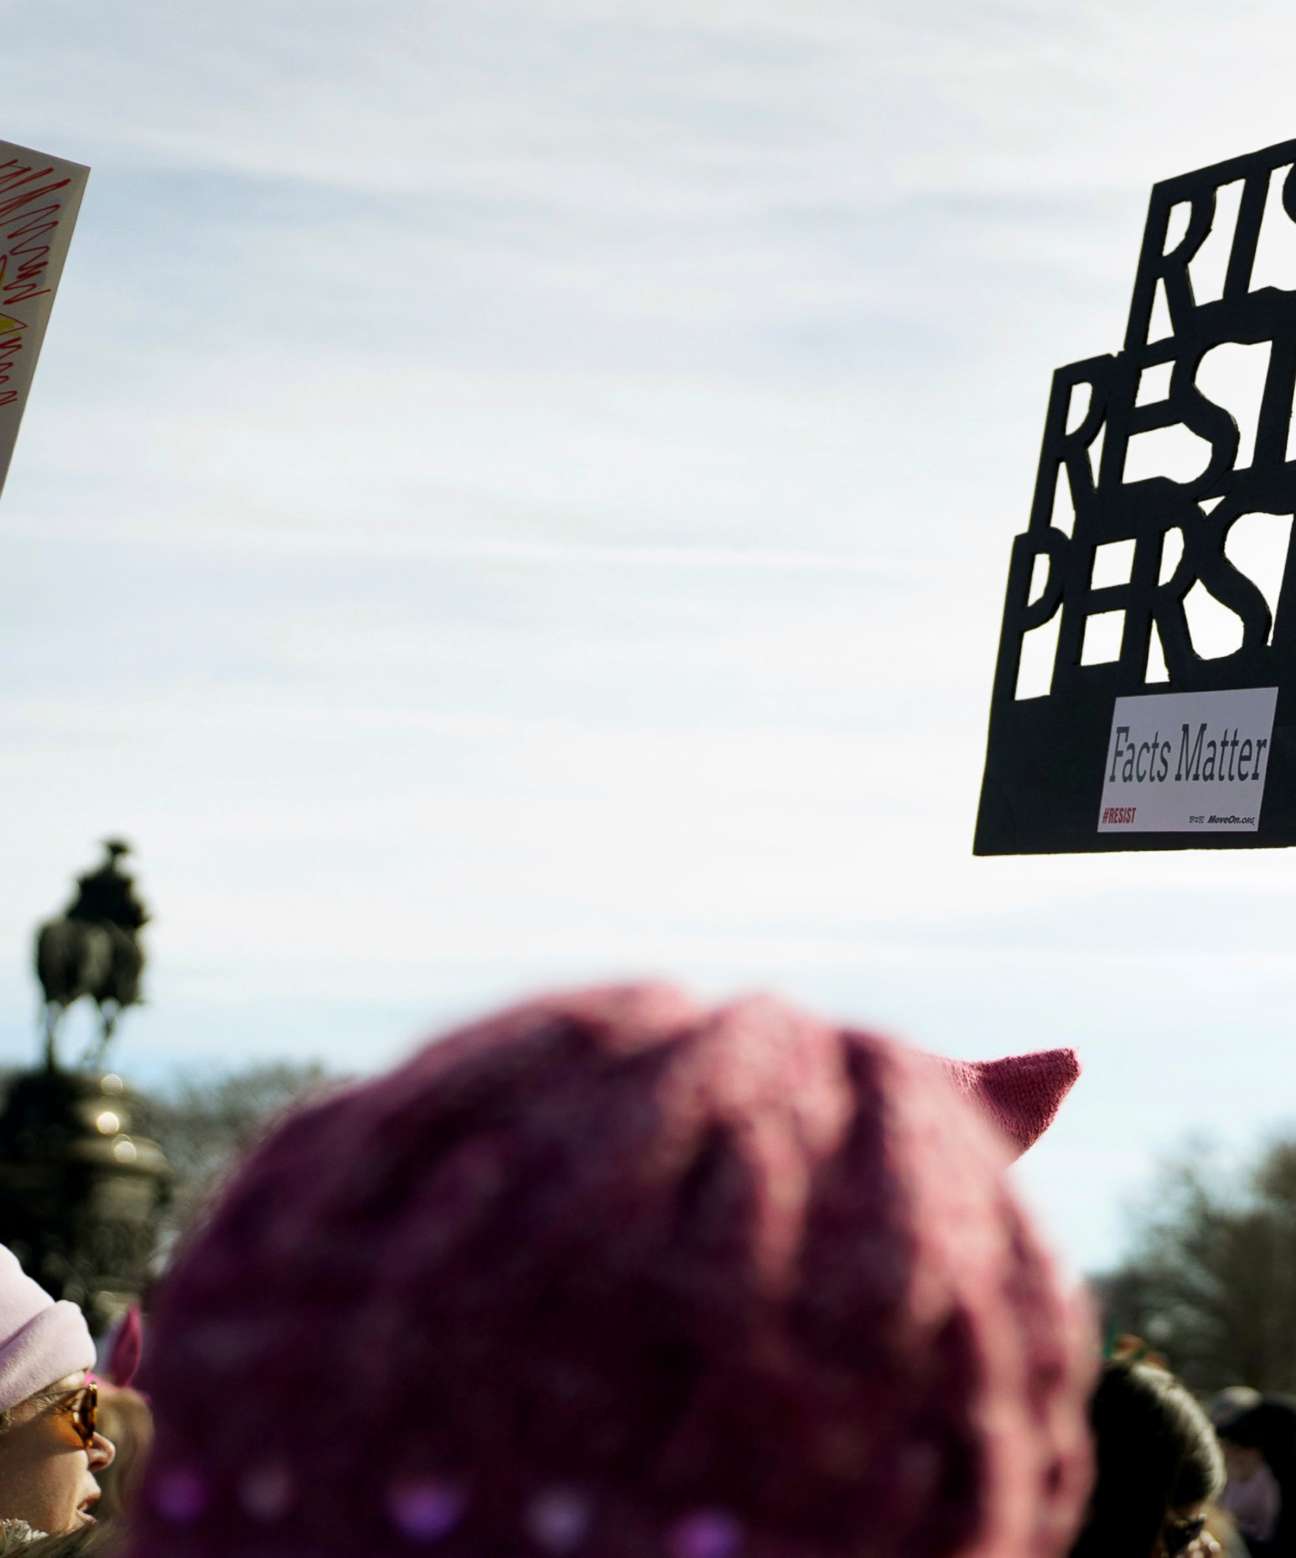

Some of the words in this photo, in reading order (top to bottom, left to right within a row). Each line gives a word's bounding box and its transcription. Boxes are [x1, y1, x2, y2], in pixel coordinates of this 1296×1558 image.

[1109, 726, 1171, 783] Facts
[1174, 723, 1268, 783] Matter
[1102, 806, 1137, 824] #RESIST
